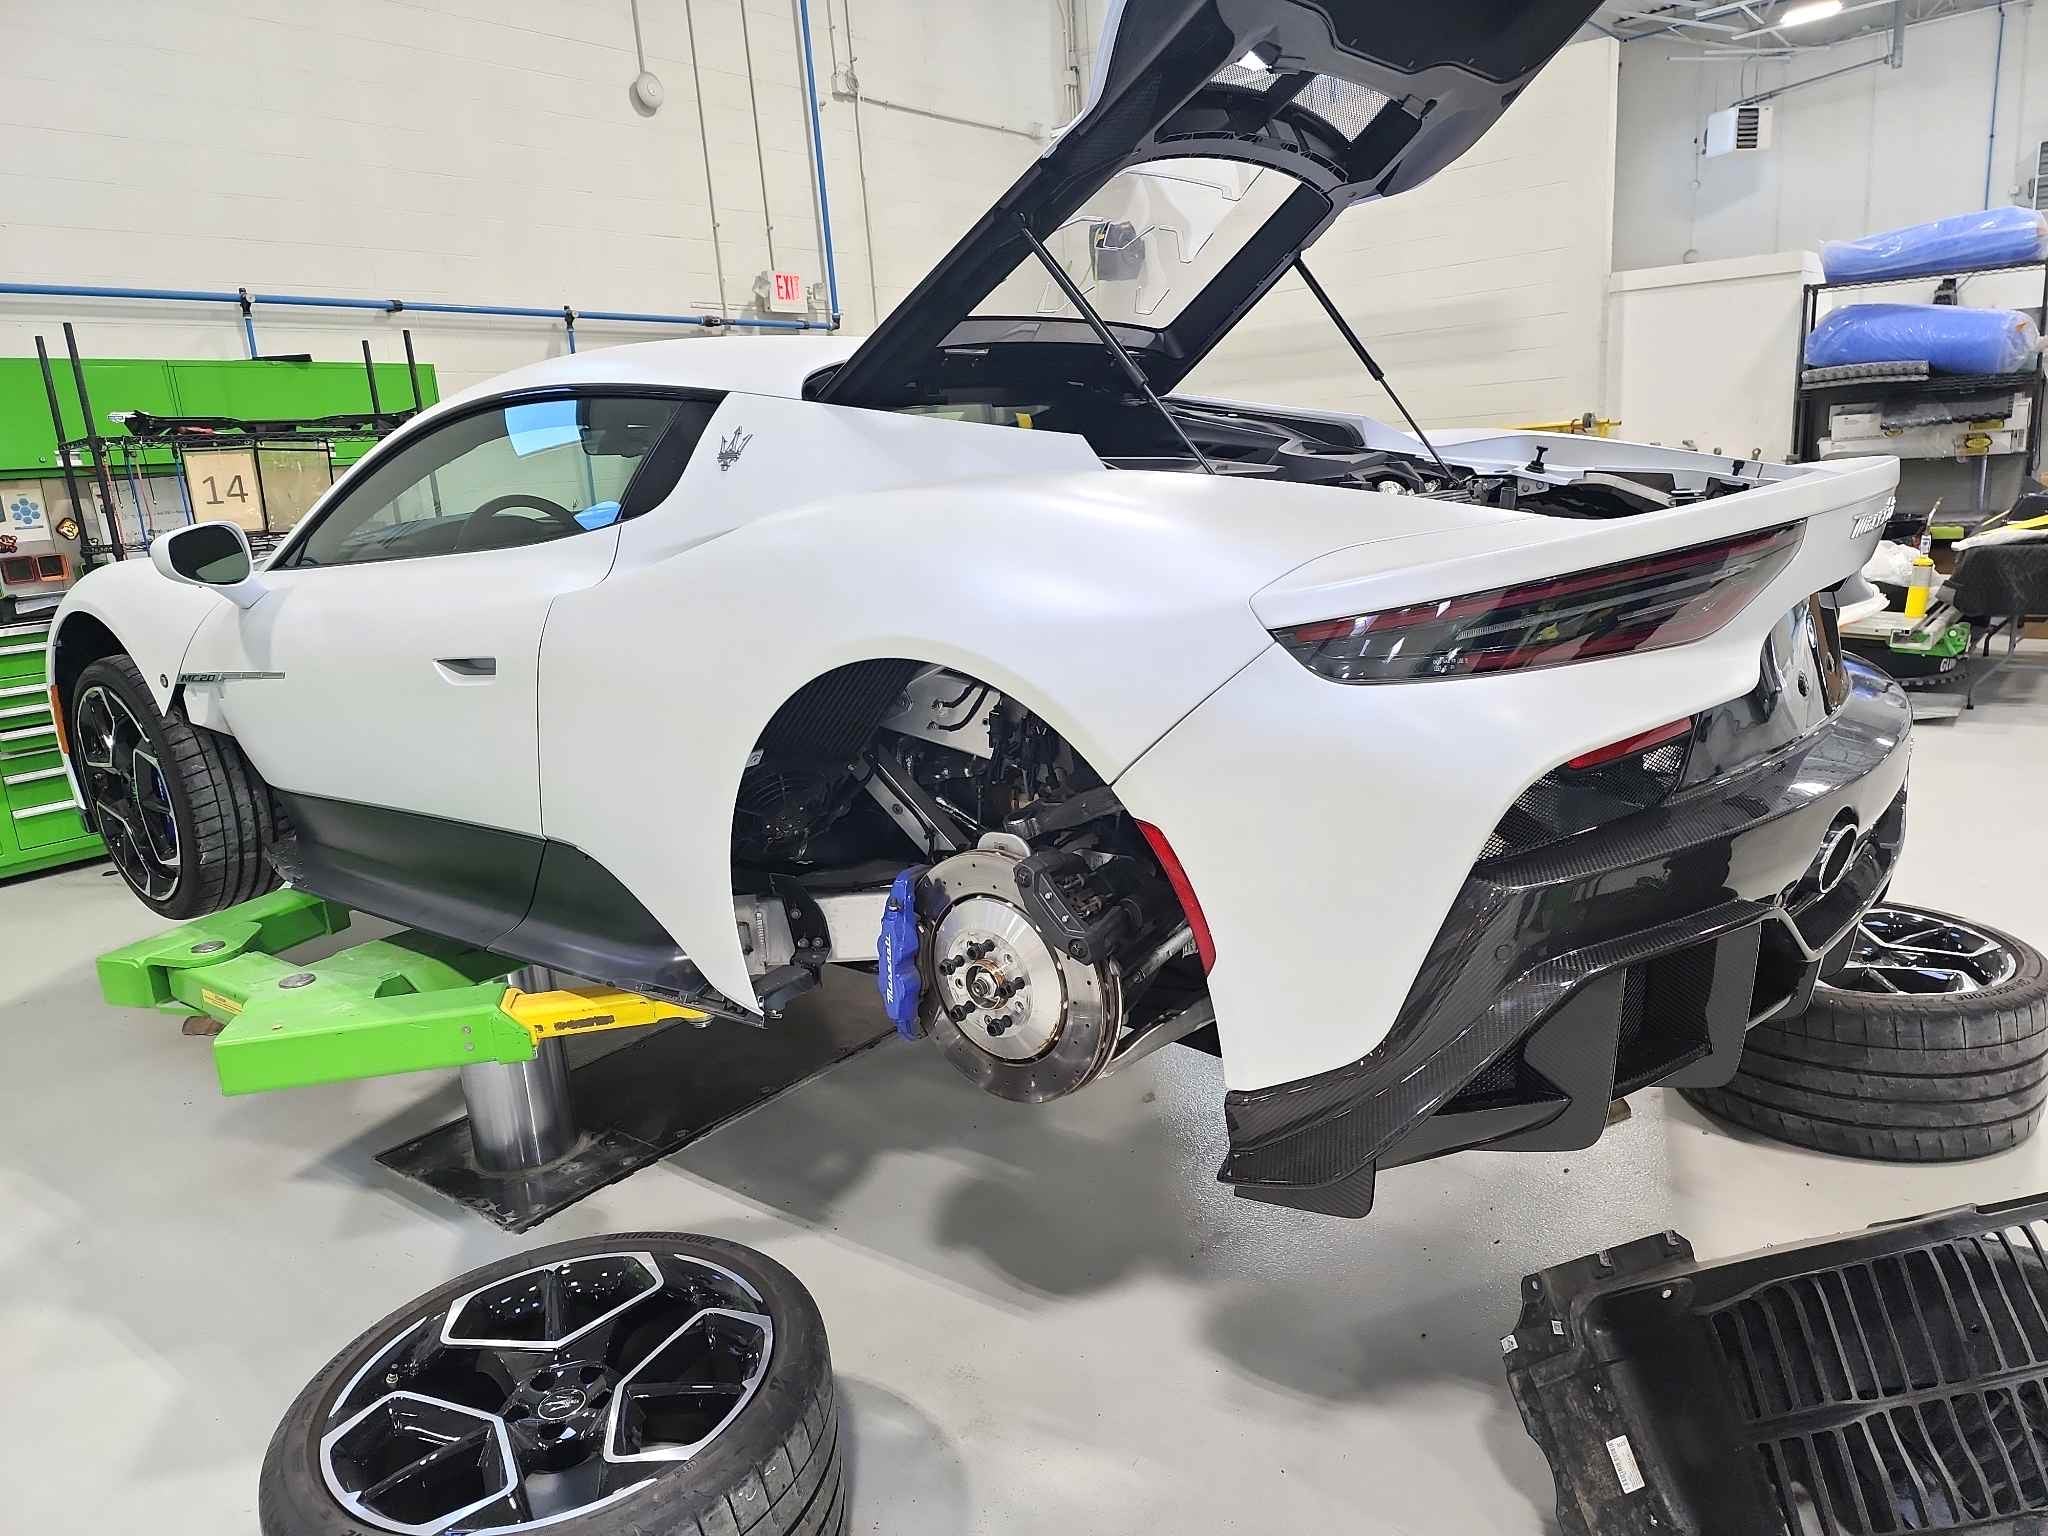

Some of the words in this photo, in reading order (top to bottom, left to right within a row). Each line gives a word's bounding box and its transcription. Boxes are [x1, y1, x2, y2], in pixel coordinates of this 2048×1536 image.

[775, 274, 800, 300] EXIT
[202, 474, 248, 504] 14
[180, 674, 216, 682] MC20
[886, 933, 894, 1004] Maserati
